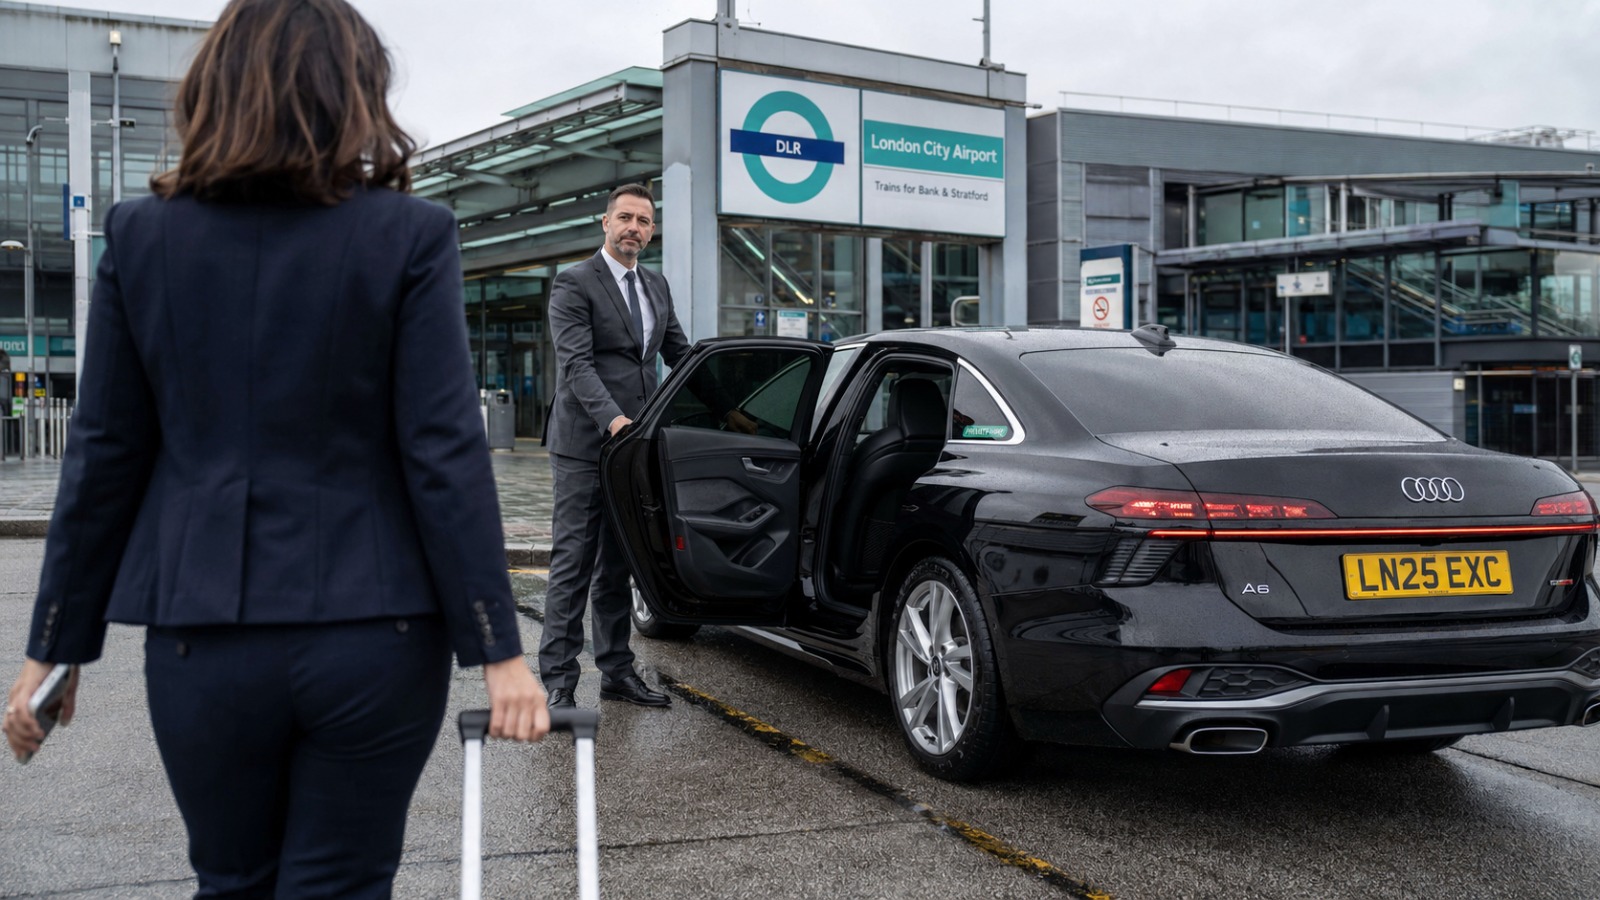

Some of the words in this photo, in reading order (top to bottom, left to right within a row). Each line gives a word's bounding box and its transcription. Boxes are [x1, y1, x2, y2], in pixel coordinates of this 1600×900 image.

[776, 140, 802, 155] DLR
[871, 134, 921, 154] London
[923, 140, 950, 161] City
[953, 143, 997, 164] Airport
[875, 181, 901, 193] Trains
[903, 183, 916, 195] for
[918, 185, 940, 196] Bank
[941, 187, 949, 198] &
[951, 188, 988, 201] Stratford
[1357, 557, 1439, 592] LN25
[1445, 556, 1502, 589] EXC
[1241, 583, 1270, 594] A6
